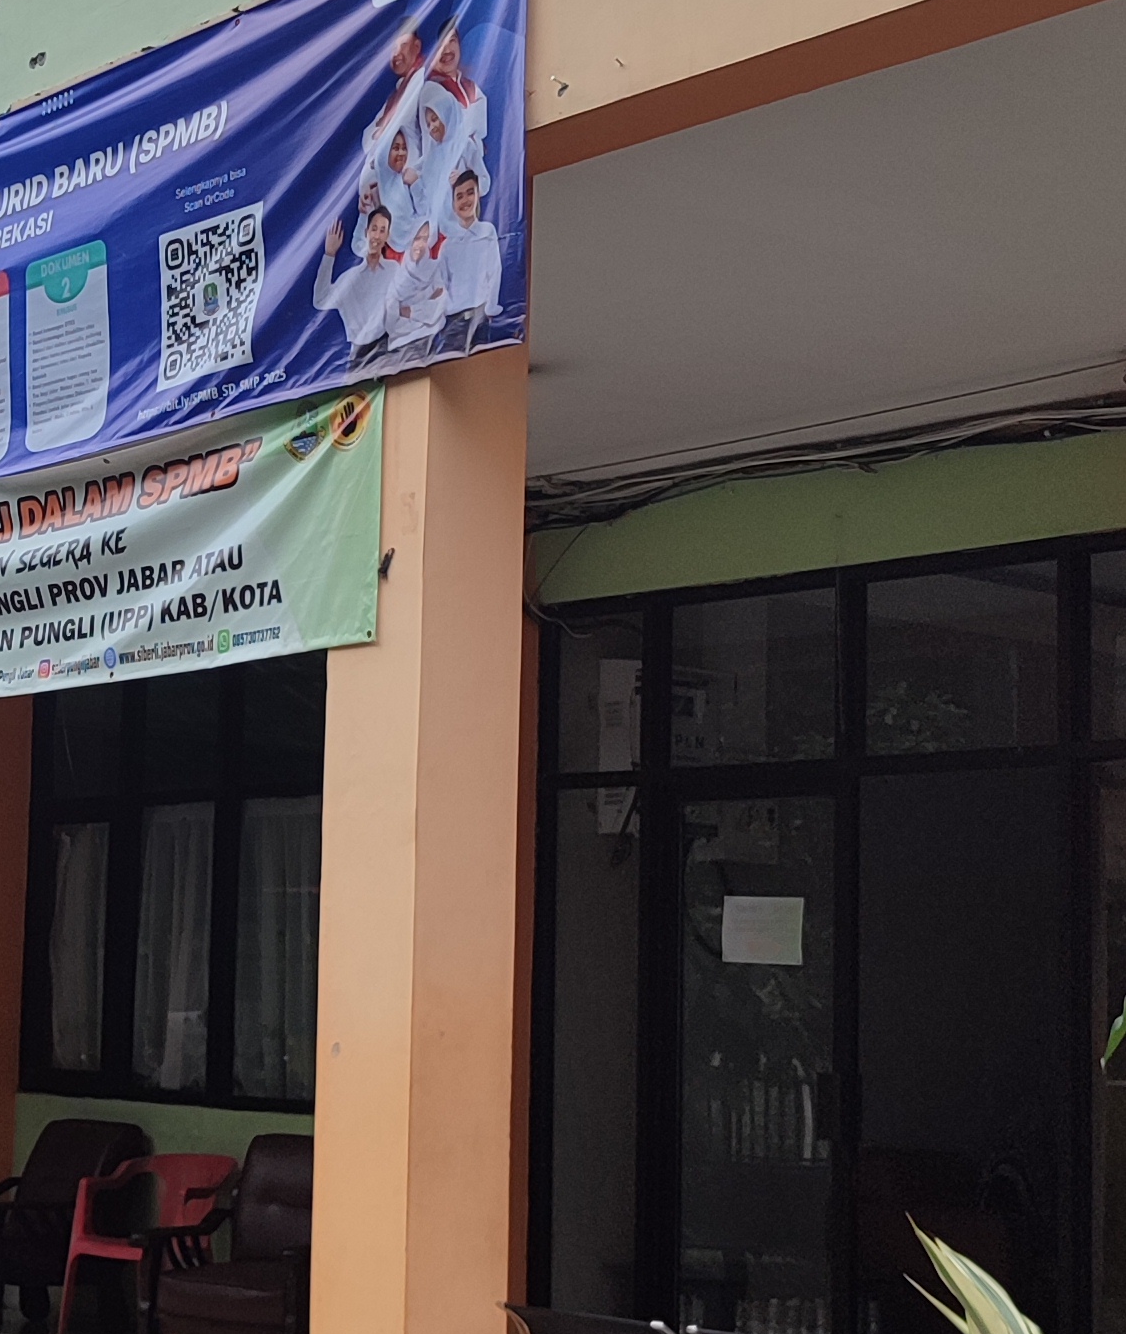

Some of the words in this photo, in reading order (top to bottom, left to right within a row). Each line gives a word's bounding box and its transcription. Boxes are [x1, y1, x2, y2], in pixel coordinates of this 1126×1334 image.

[52, 142, 124, 199] BARU
[129, 101, 228, 174] (SPMB)
[175, 173, 229, 199] Selengkapnya
[229, 167, 247, 180] bisa
[184, 198, 203, 213] Scan
[41, 250, 90, 278] DOKUMEN
[61, 276, 72, 299] 2
[18, 472, 135, 539] DALAM
[15, 535, 93, 574] SEGERA
[101, 527, 128, 556] KE
[48, 573, 109, 607] PROV
[116, 559, 185, 595] JABAR
[189, 543, 244, 580] ATAU
[19, 614, 95, 649] PUNGLI
[100, 602, 154, 640] (UPP)
[160, 579, 283, 624] KAB/KOTA
